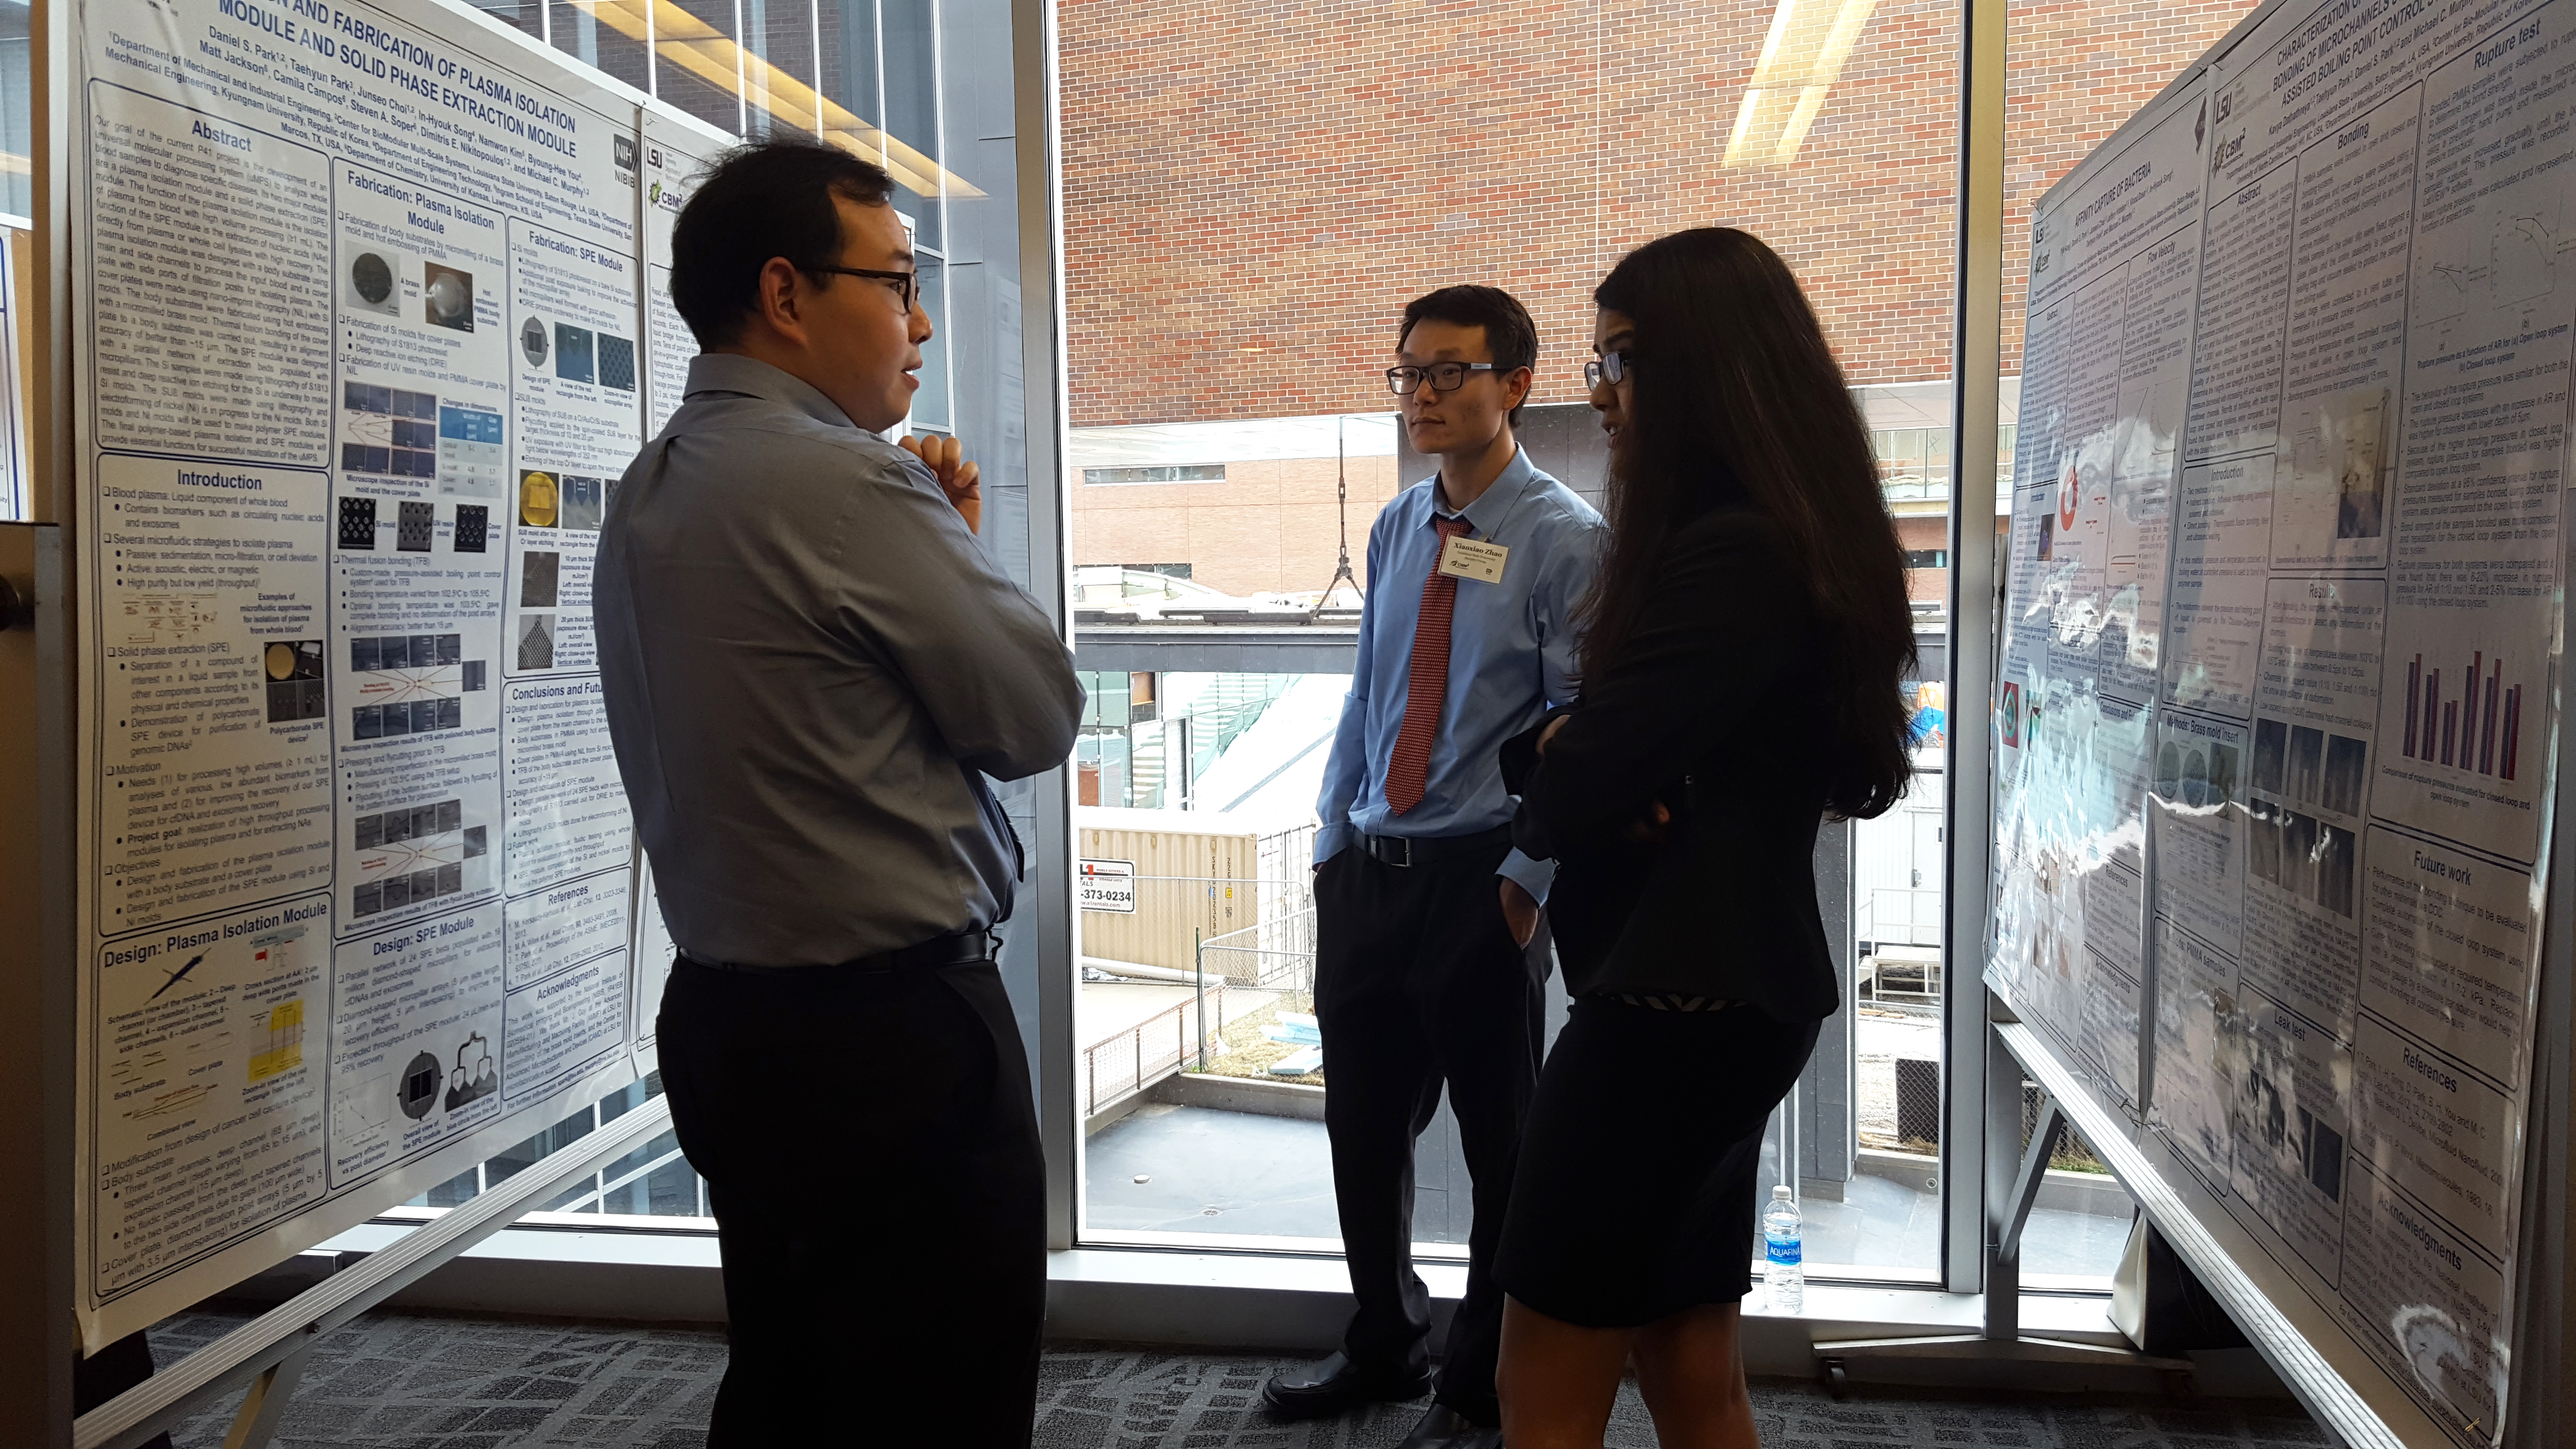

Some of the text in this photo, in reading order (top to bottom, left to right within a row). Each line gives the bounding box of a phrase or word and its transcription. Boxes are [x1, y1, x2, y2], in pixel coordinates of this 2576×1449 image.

[2273, 0, 2389, 92] BONDING OF MICROCHANNELS
[2278, 0, 2350, 65] CHARACTERIZATION
[2474, 17, 2541, 69] Rupture test
[292, 0, 575, 135] AND FABRICATION OF PLASMA ISOLATION
[2281, 72, 2316, 108] ASSISTED
[2318, 47, 2351, 82] BOILING
[2352, 27, 2378, 59] POINT
[2380, 0, 2424, 39] CONTROL
[220, 0, 576, 160] MODULE AND SOLID PHASE EXTRACTION MODULE
[172, 56, 180, 65] of
[184, 59, 229, 83] Mechanical
[232, 79, 247, 90] and
[249, 82, 285, 104] Industrial
[361, 124, 370, 135] for
[372, 128, 408, 149] BioModular
[200, 42, 221, 59] Matt
[274, 70, 305, 91] Camila
[351, 99, 378, 119] Steven
[381, 111, 389, 123] A.
[421, 127, 449, 146] Dimitris
[451, 138, 458, 149] E.
[514, 164, 525, 175] and
[527, 167, 551, 185] Michael
[553, 177, 559, 188] C.
[209, 26, 240, 48] Daniel
[242, 39, 252, 53] S.
[290, 59, 328, 83] Taehyun
[357, 85, 386, 106] Junseo
[419, 110, 451, 131] In-Hyouk
[479, 133, 507, 154] Namwon
[528, 153, 565, 176] Byoung-Hee
[2216, 92, 2232, 125] LSU
[192, 120, 251, 152] Abstract
[2337, 122, 2368, 149] Bonding
[616, 143, 632, 163] NIH
[646, 146, 662, 168] LSU
[430, 175, 458, 193] University
[615, 170, 635, 188] NIBIB
[2490, 148, 2574, 193] calculated and represented
[348, 172, 494, 229] Fabrication: Plasma Isolation
[2075, 203, 2093, 228] AFFINITY
[2095, 188, 2115, 214] CAPTURE
[2125, 161, 2151, 192] BACTERIA
[2238, 185, 2261, 204] Abstract
[408, 211, 443, 234] Module
[530, 229, 622, 273] Fabrication: SPE Module
[178, 469, 261, 491] Introduction
[2211, 467, 2243, 481] Introduction
[1454, 542, 1483, 553] Xiaoxiao
[1484, 549, 1502, 557] Zhao
[513, 686, 564, 699] Conclusions
[567, 683, 582, 695] and
[2190, 719, 2206, 735] Brass
[2207, 726, 2220, 739] mold
[2222, 728, 2238, 744] insert
[128, 831, 159, 843] Project
[2414, 851, 2471, 886] Future work
[548, 886, 588, 904] References
[105, 903, 326, 966] Design: Plasma Isolation Module
[373, 918, 474, 956] Design: SPE Module
[537, 966, 599, 1000] Acknowledgments
[2274, 1010, 2306, 1042] Leak test
[2403, 1046, 2456, 1093] References
[2378, 1194, 2462, 1271] Acknowledgments
[1770, 1246, 1800, 1257] AQUAFINA
